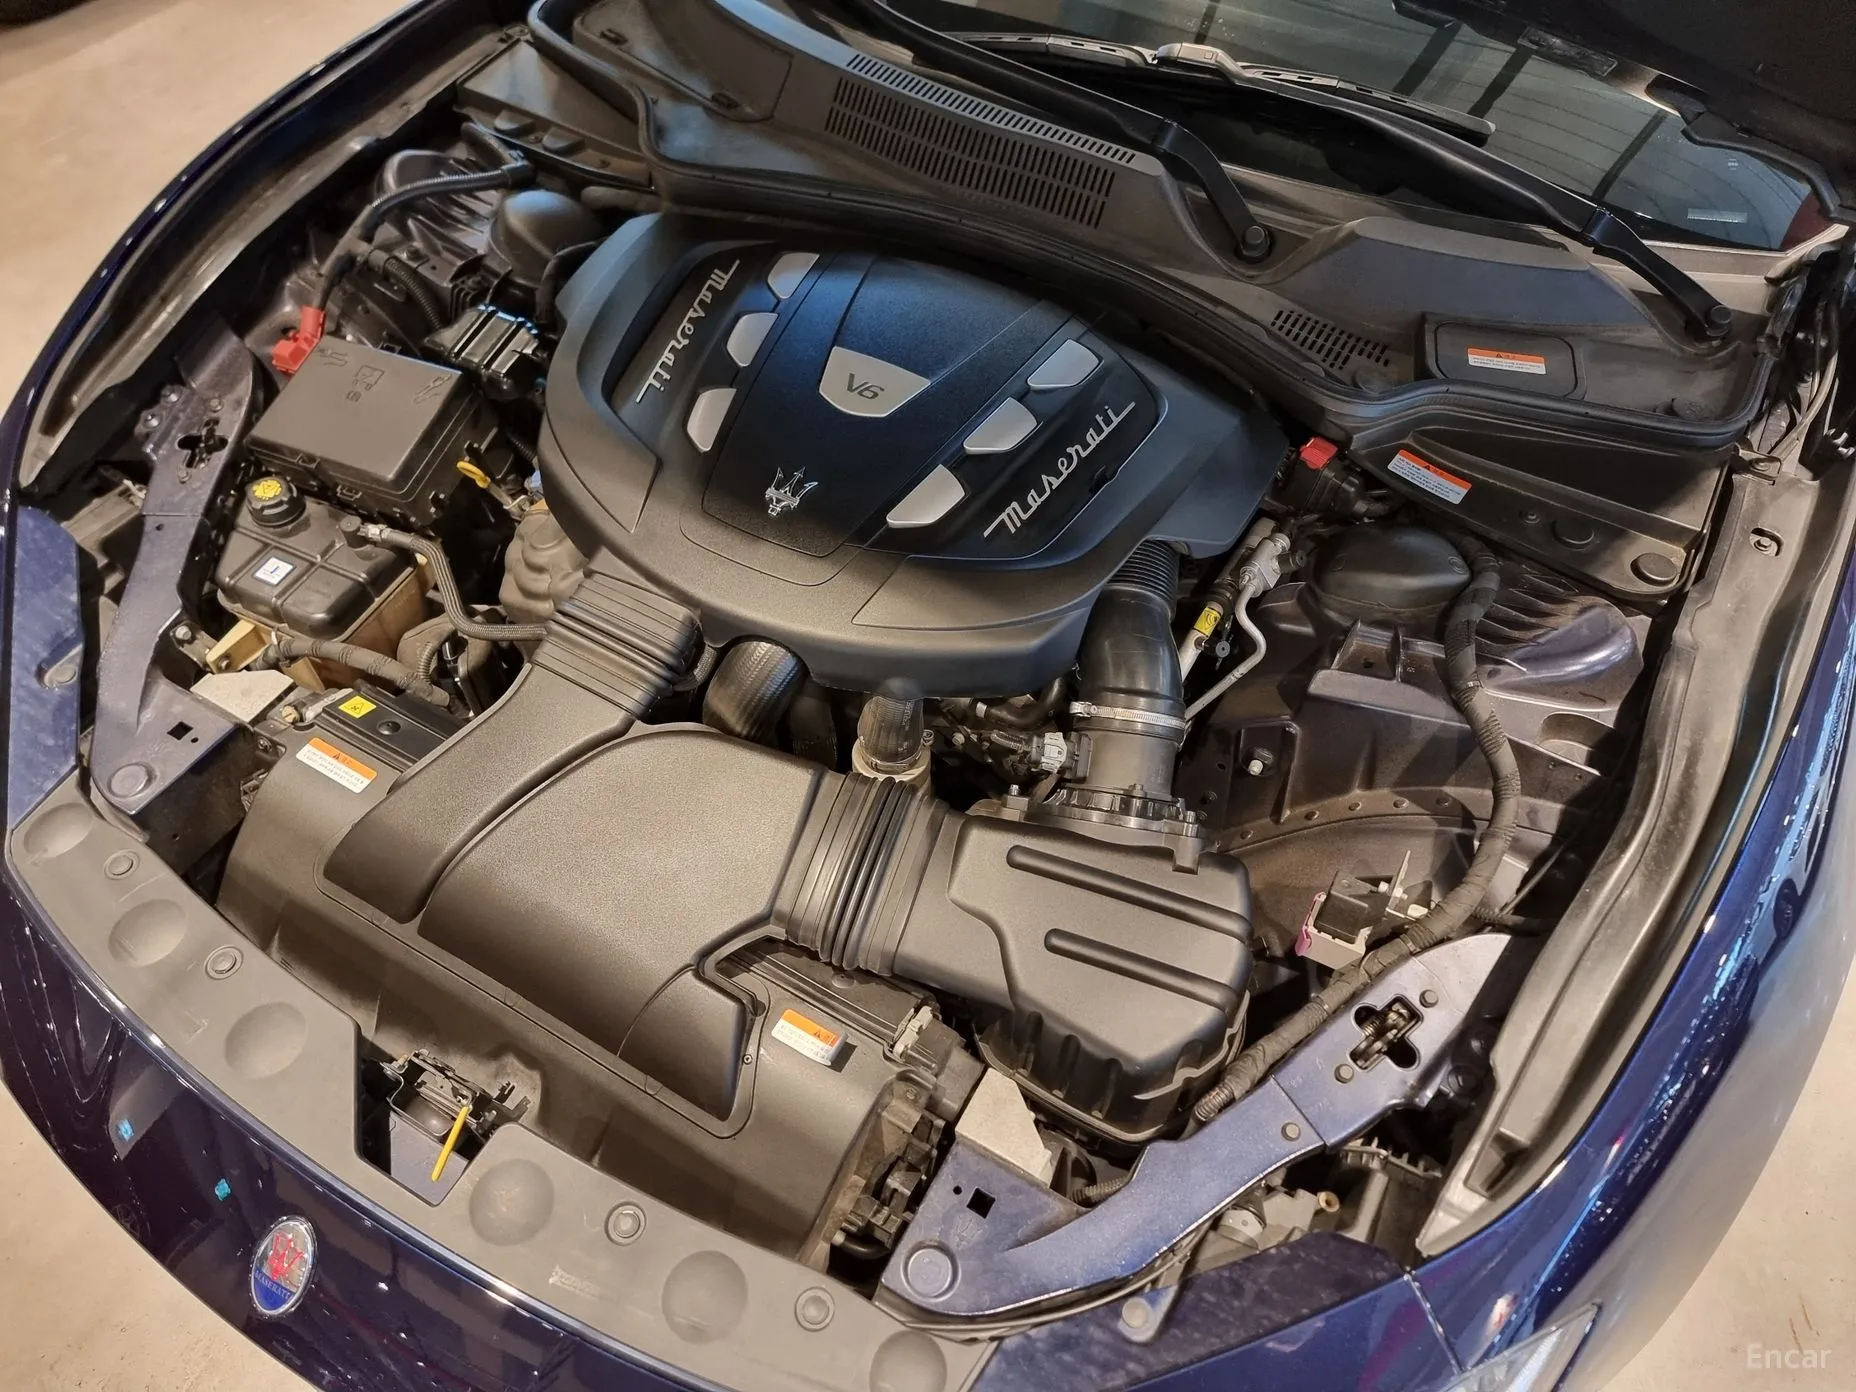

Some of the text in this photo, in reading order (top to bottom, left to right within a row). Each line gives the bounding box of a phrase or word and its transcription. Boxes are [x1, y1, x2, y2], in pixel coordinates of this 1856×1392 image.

[636, 259, 740, 403] Maserati
[846, 373, 885, 400] V6
[983, 401, 1136, 538] Maserati
[254, 1270, 291, 1300] MASERATI
